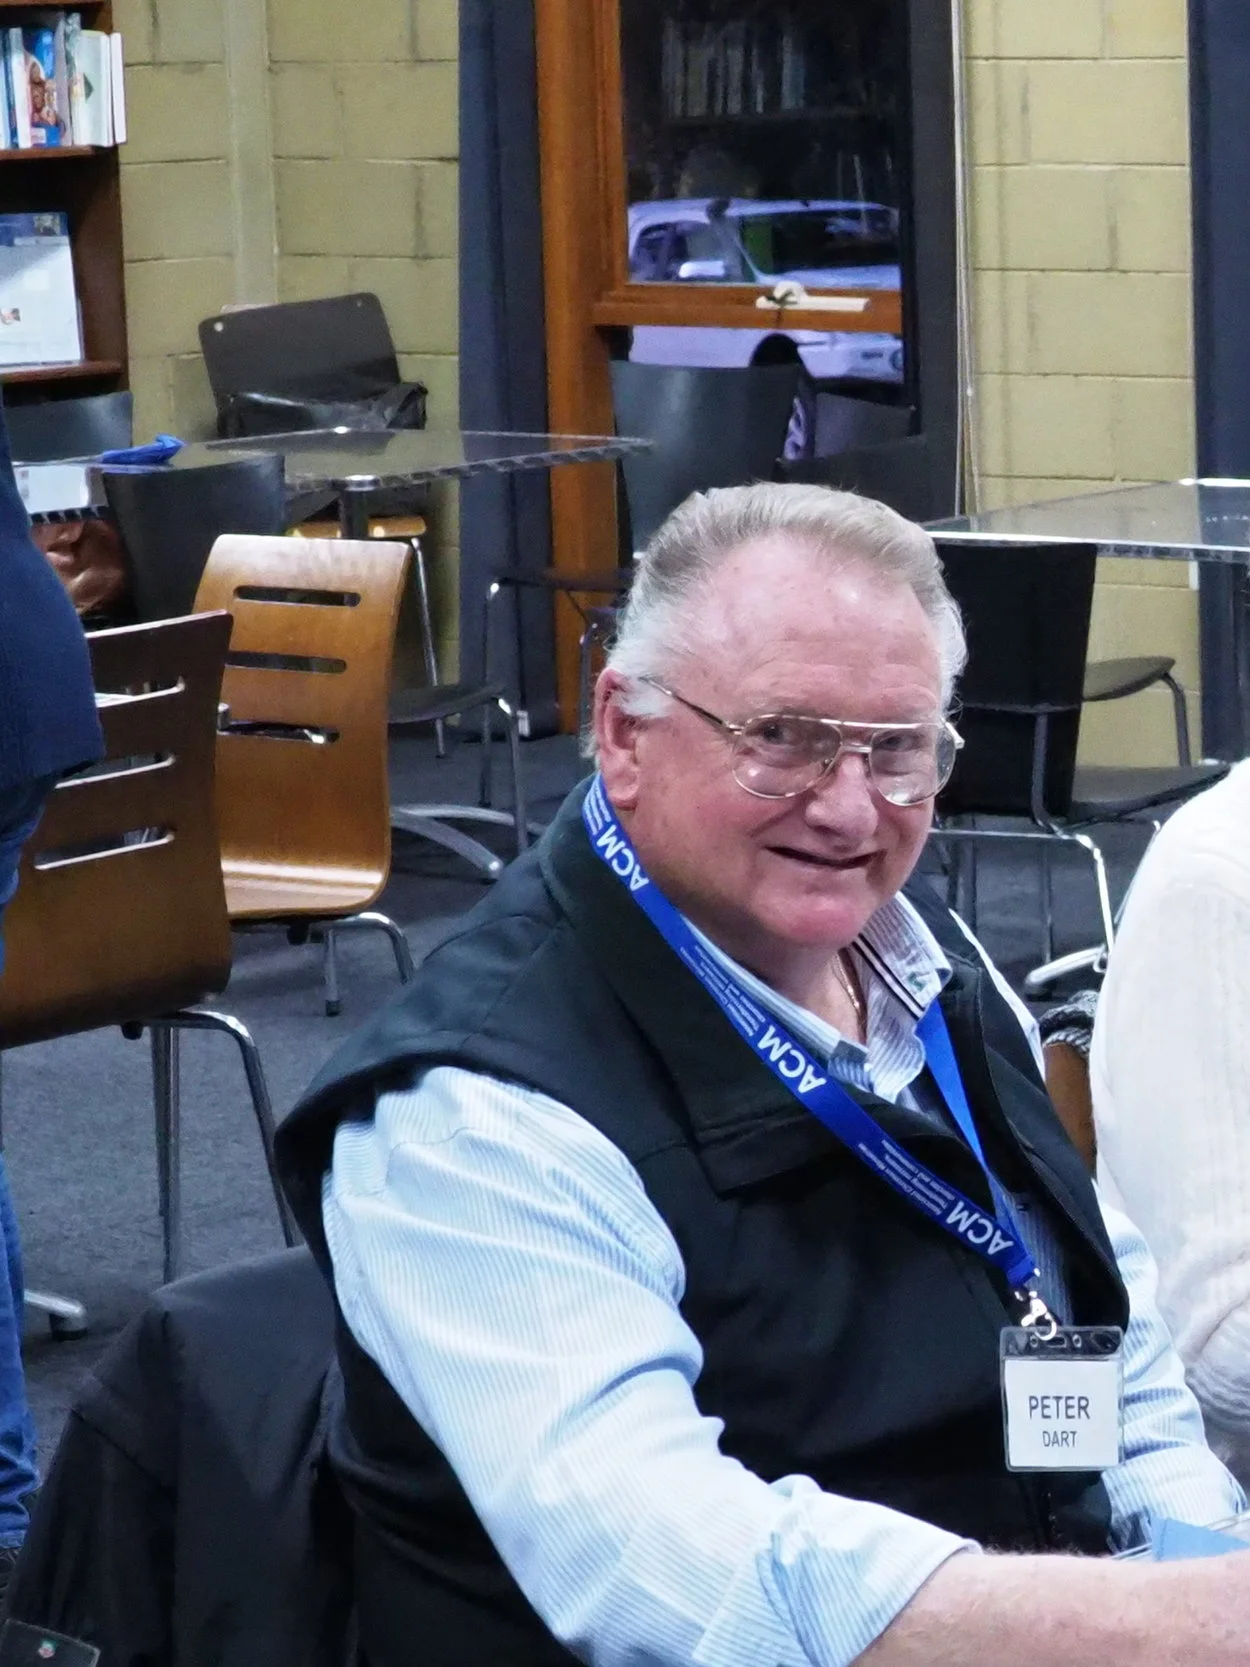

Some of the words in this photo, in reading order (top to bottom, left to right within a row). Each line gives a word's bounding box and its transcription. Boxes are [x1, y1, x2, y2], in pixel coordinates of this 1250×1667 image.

[597, 824, 649, 891] ACM
[757, 1025, 827, 1093] ACM
[946, 1201, 1014, 1255] ACM
[1028, 1395, 1090, 1420] PETER
[1042, 1431, 1077, 1447] DART
